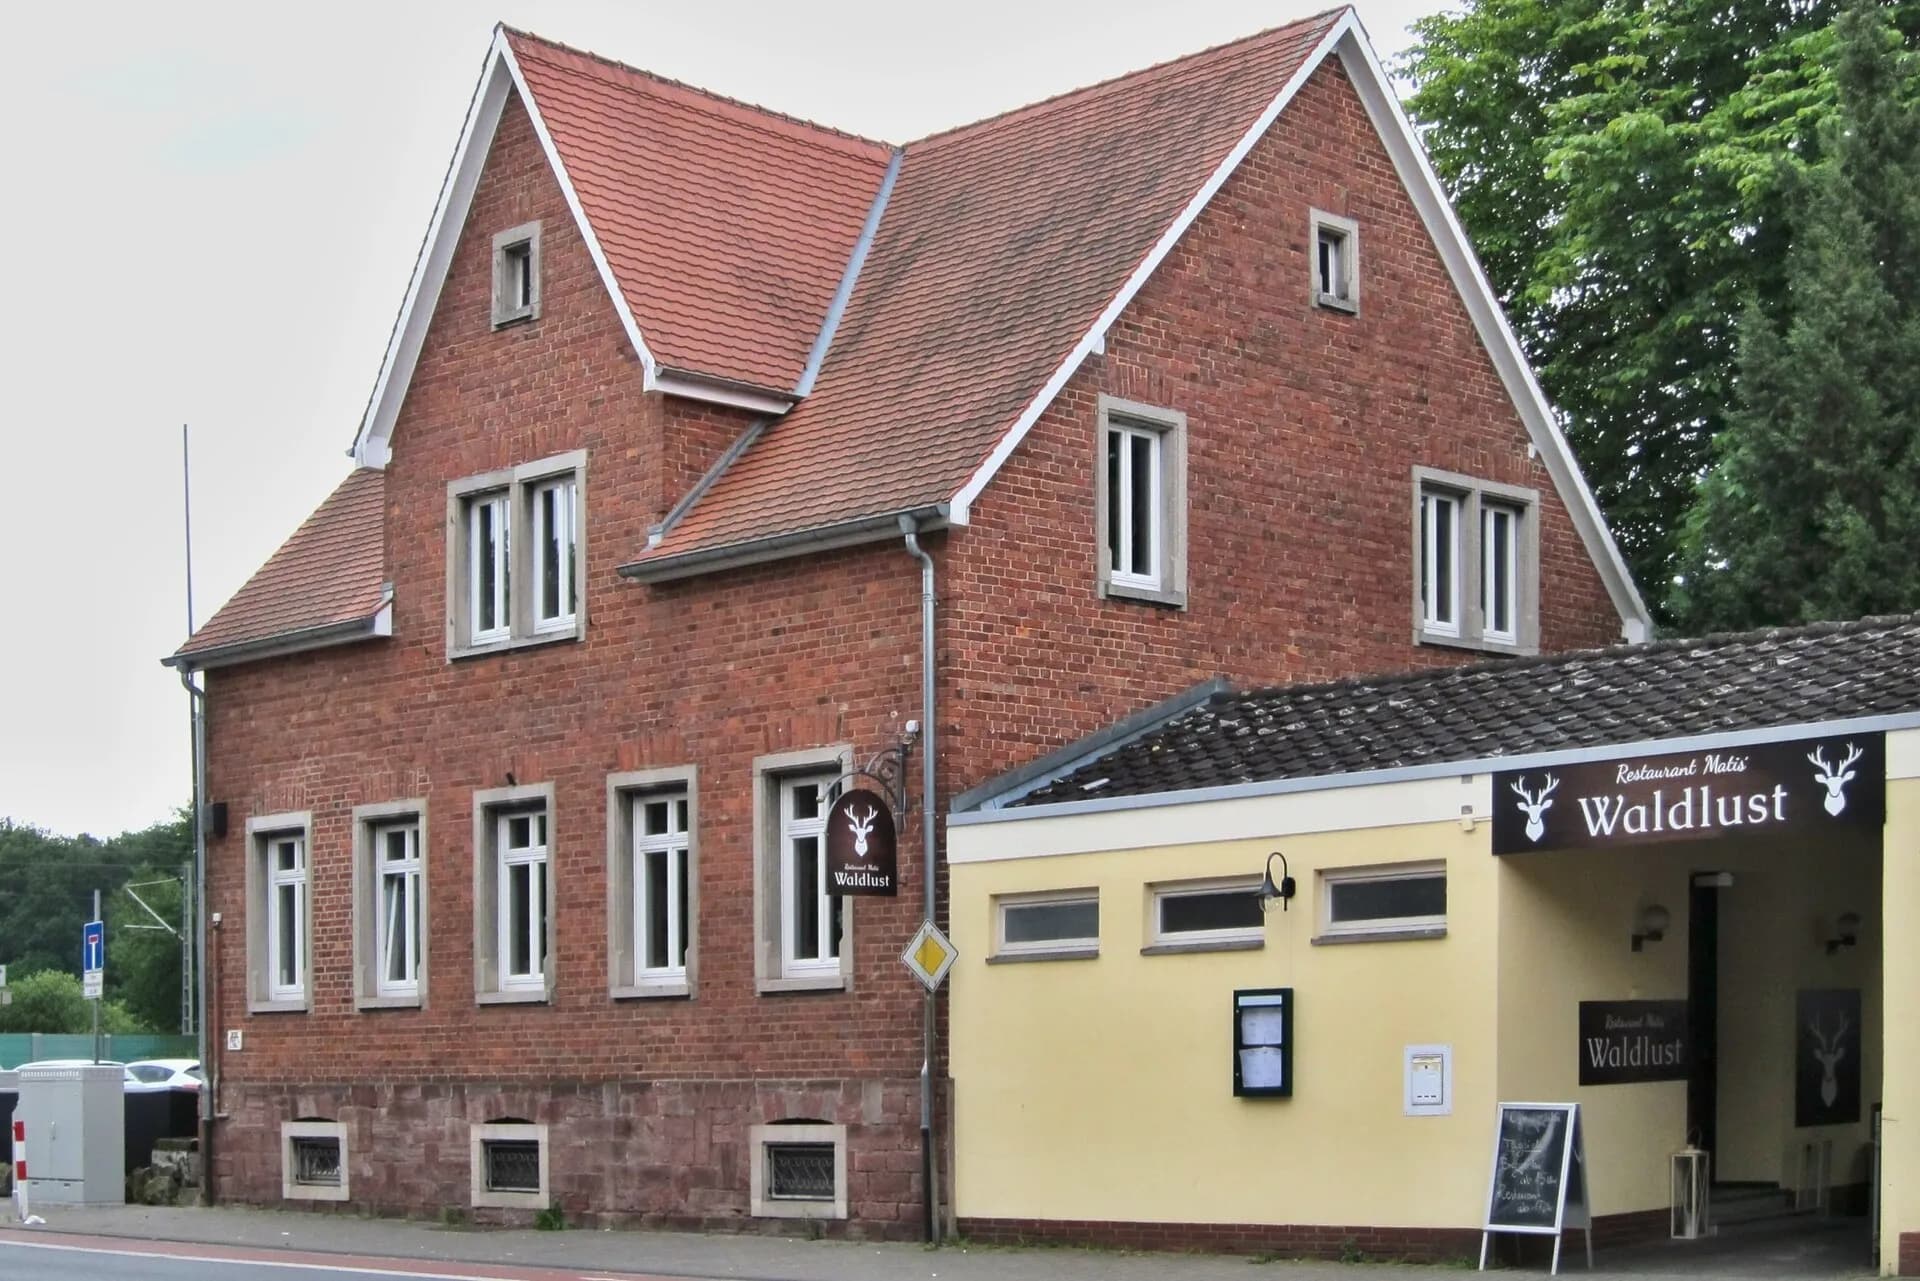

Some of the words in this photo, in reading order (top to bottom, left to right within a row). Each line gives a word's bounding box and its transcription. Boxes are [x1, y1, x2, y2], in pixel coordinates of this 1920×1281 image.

[1615, 758, 1697, 785] Restaurant
[1577, 783, 1789, 838] Waldlust
[834, 872, 889, 887] Waldlust
[1586, 1035, 1684, 1068] Waldlust
